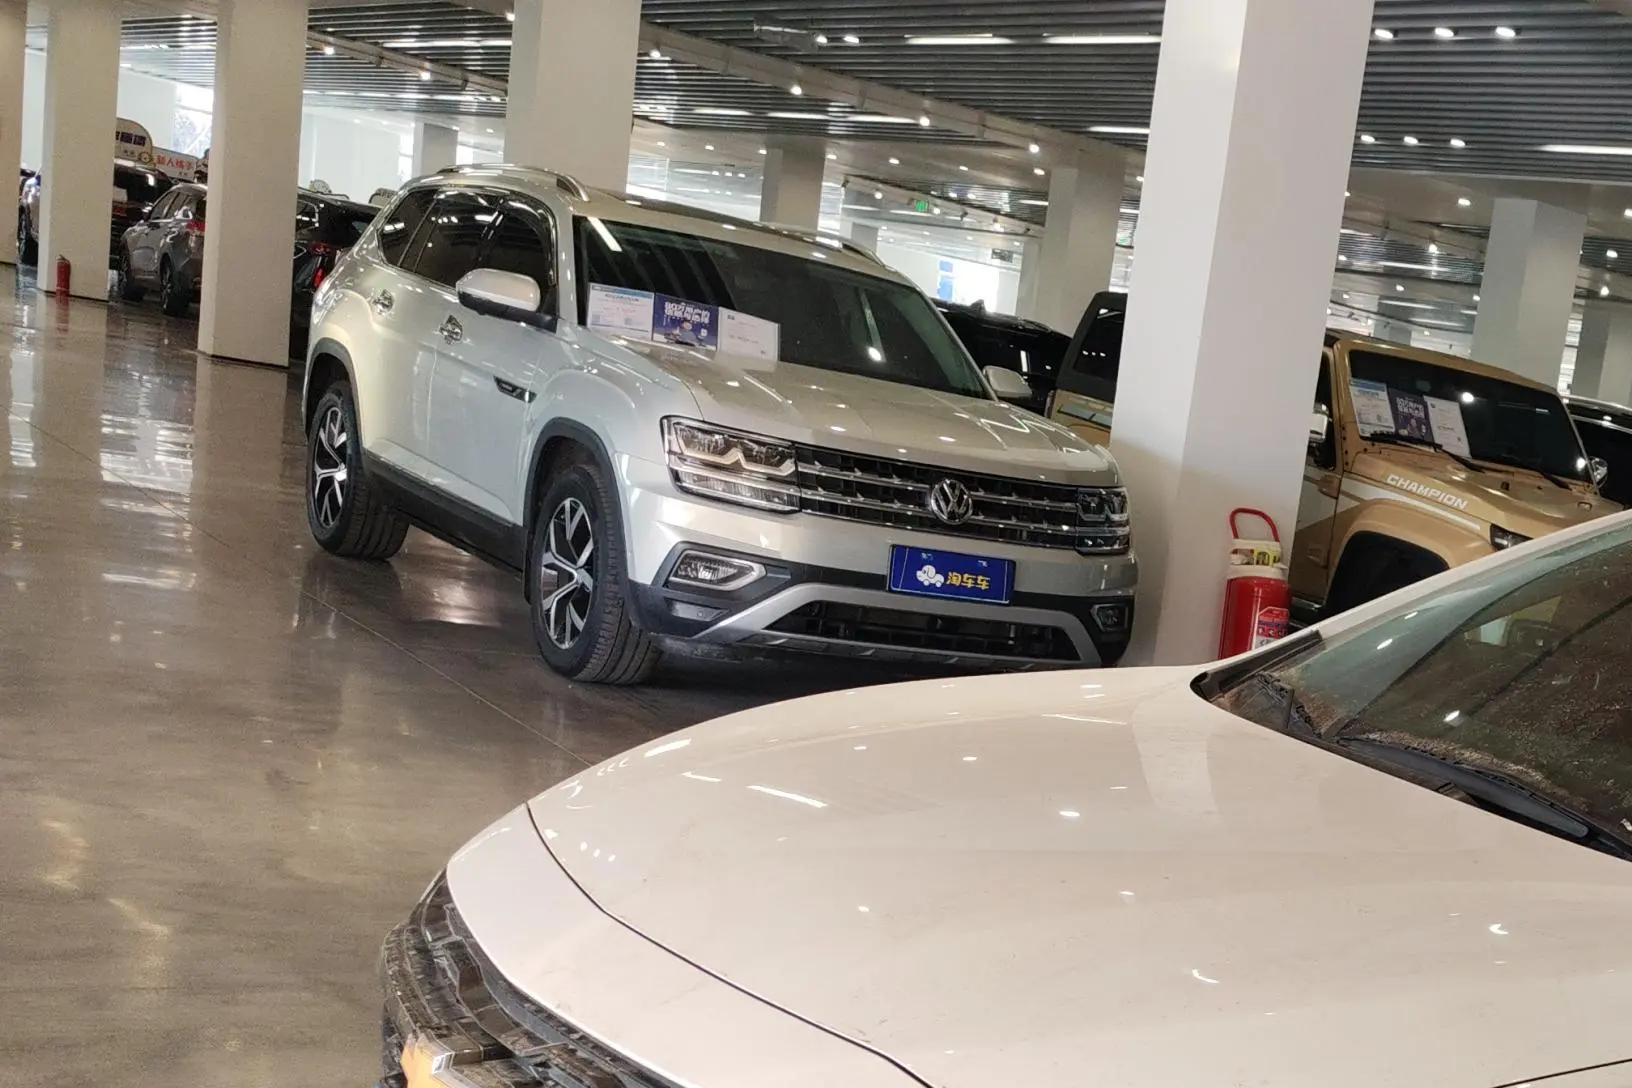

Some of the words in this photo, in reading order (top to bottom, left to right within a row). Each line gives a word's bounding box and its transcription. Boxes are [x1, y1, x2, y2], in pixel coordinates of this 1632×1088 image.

[1386, 474, 1467, 508] CHAMPION
[946, 571, 991, 590] 淘车车
